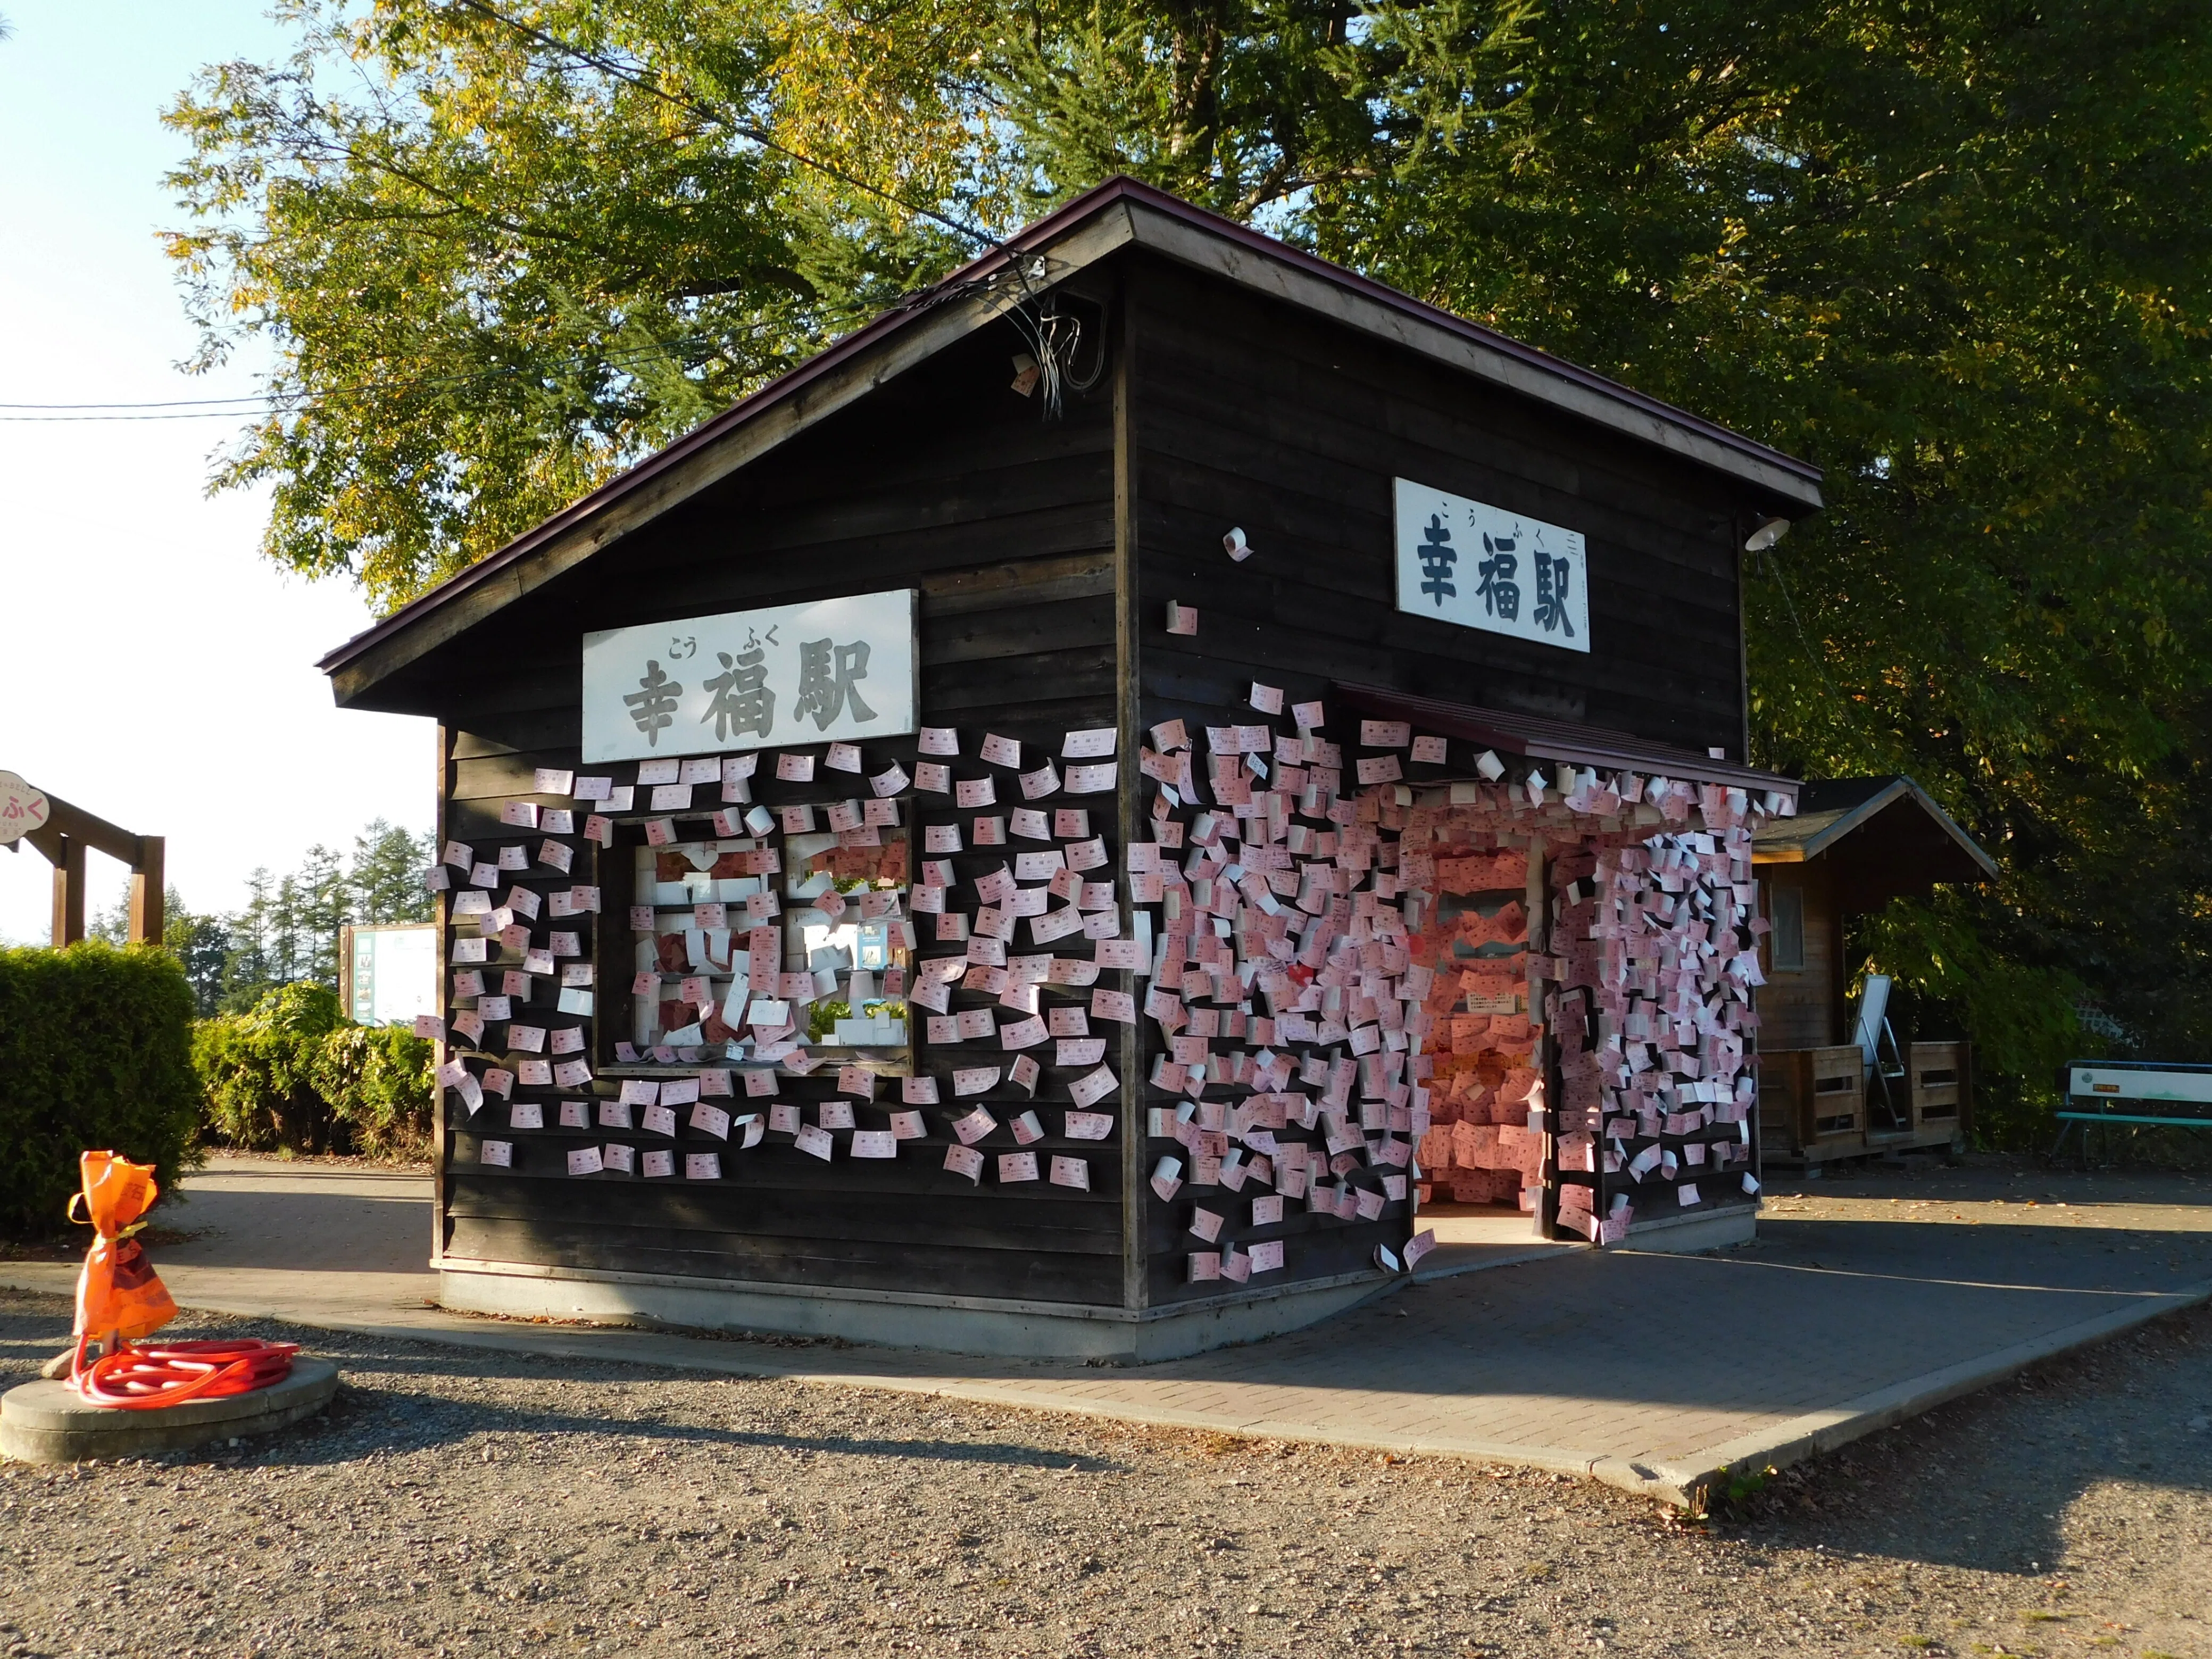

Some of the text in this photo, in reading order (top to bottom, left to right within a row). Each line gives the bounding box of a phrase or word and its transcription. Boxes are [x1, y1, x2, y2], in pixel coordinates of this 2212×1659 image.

[1417, 513, 1575, 637] 幸福駅
[622, 637, 878, 747] 幸福駅
